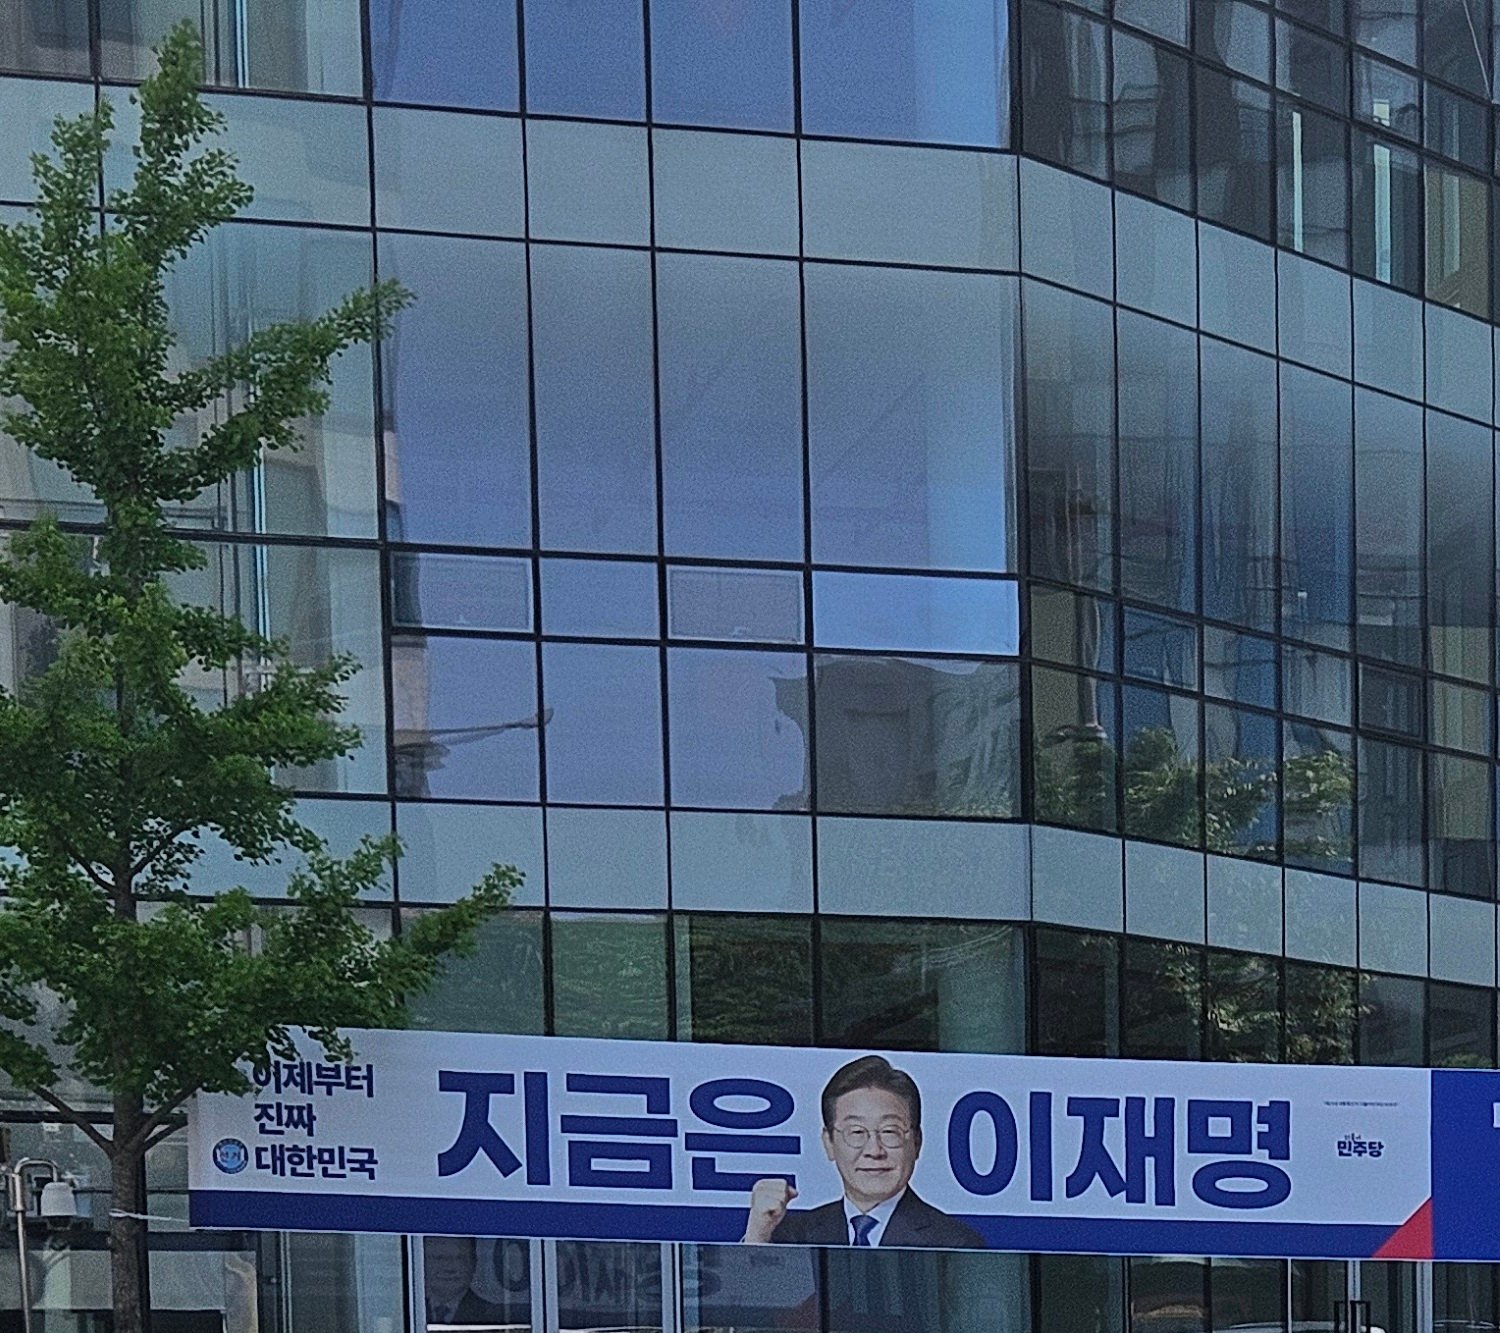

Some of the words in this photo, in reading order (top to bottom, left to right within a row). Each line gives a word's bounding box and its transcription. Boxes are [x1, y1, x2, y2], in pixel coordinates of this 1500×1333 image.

[253, 1060, 374, 1098] 이제부터
[254, 1102, 317, 1137] 진짜
[437, 1069, 801, 1192] 지금은
[255, 1143, 378, 1180] 대한민국
[948, 1091, 1292, 1209] 이재명
[1337, 1140, 1384, 1157] 민주당
